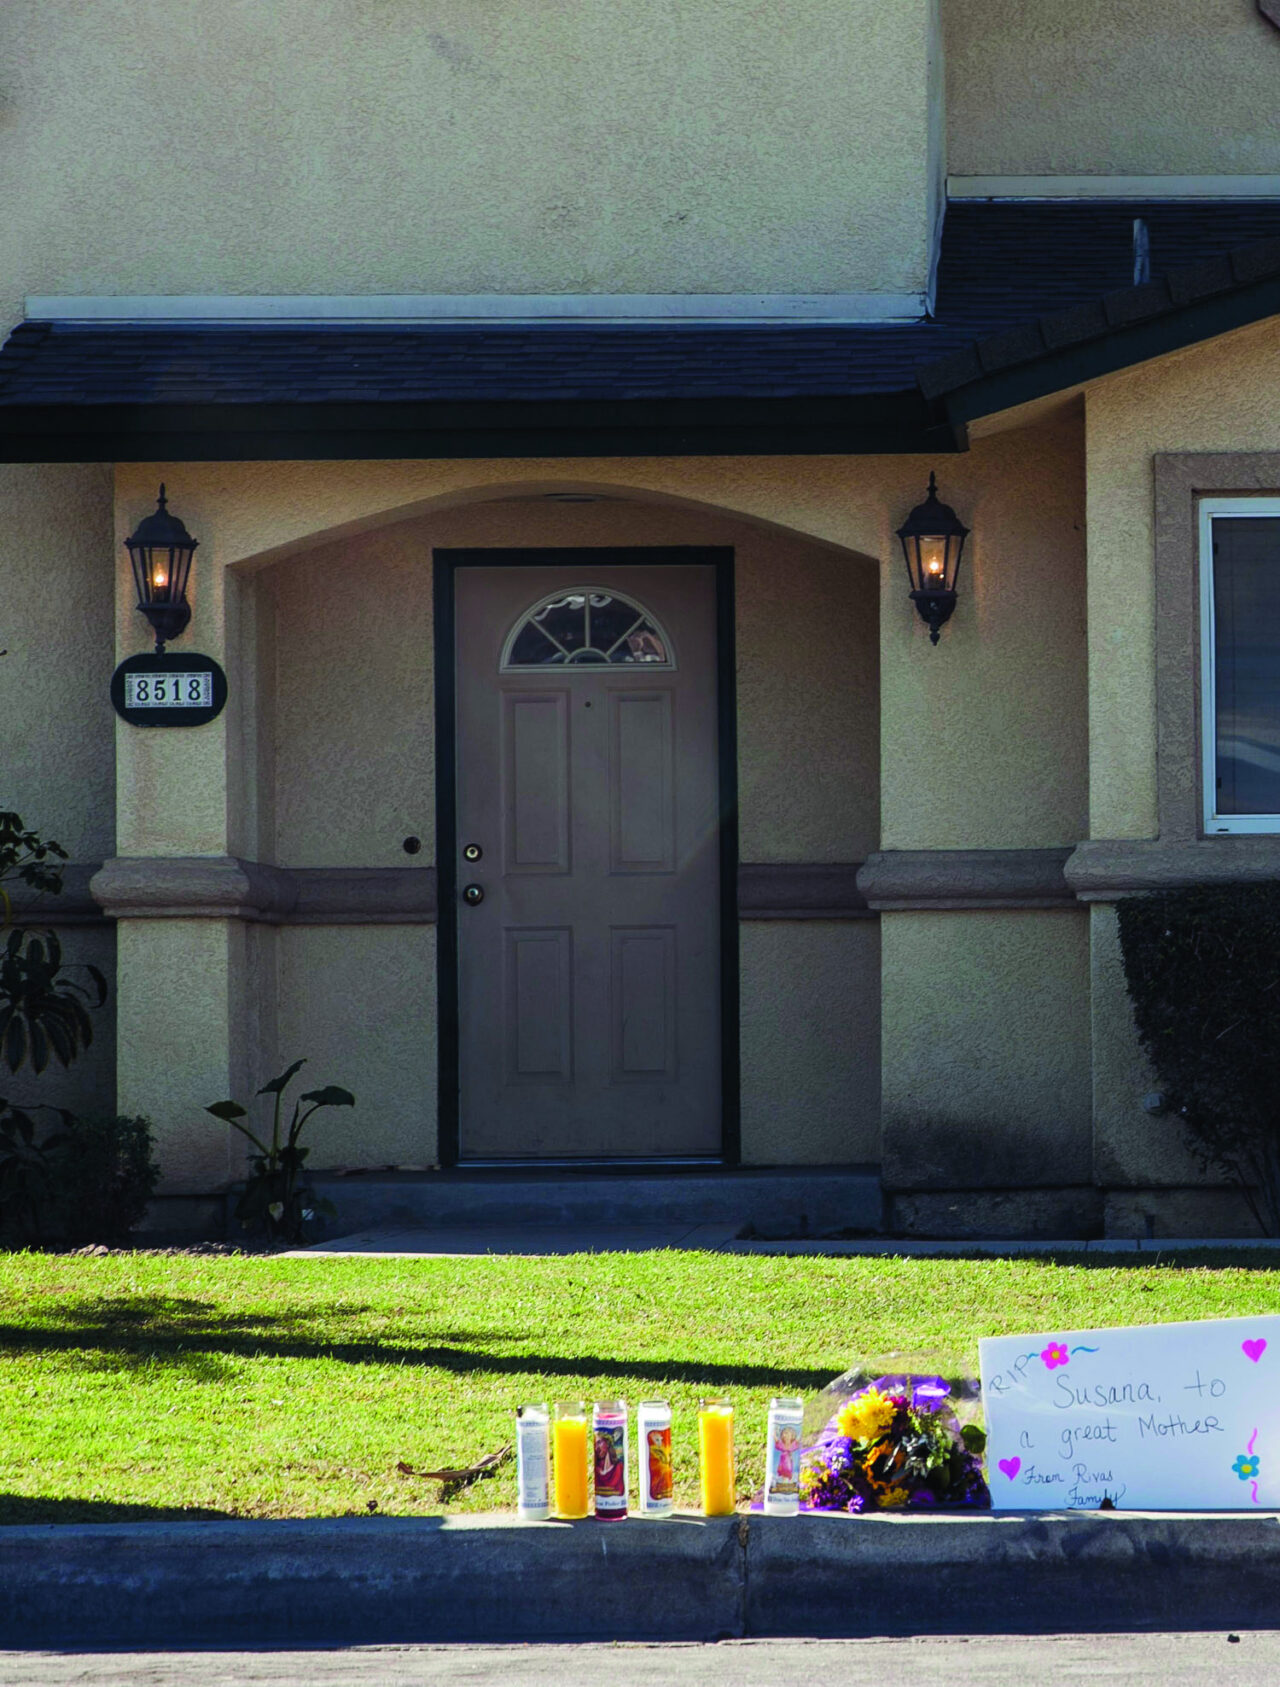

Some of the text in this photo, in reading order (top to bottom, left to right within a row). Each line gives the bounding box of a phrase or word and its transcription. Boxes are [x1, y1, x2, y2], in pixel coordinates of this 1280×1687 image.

[136, 679, 201, 701] 8518
[989, 1354, 1029, 1395] RIP
[1184, 1369, 1226, 1398] to
[1020, 1415, 1224, 1459] a great Mother
[1023, 1463, 1114, 1486] From Rivas
